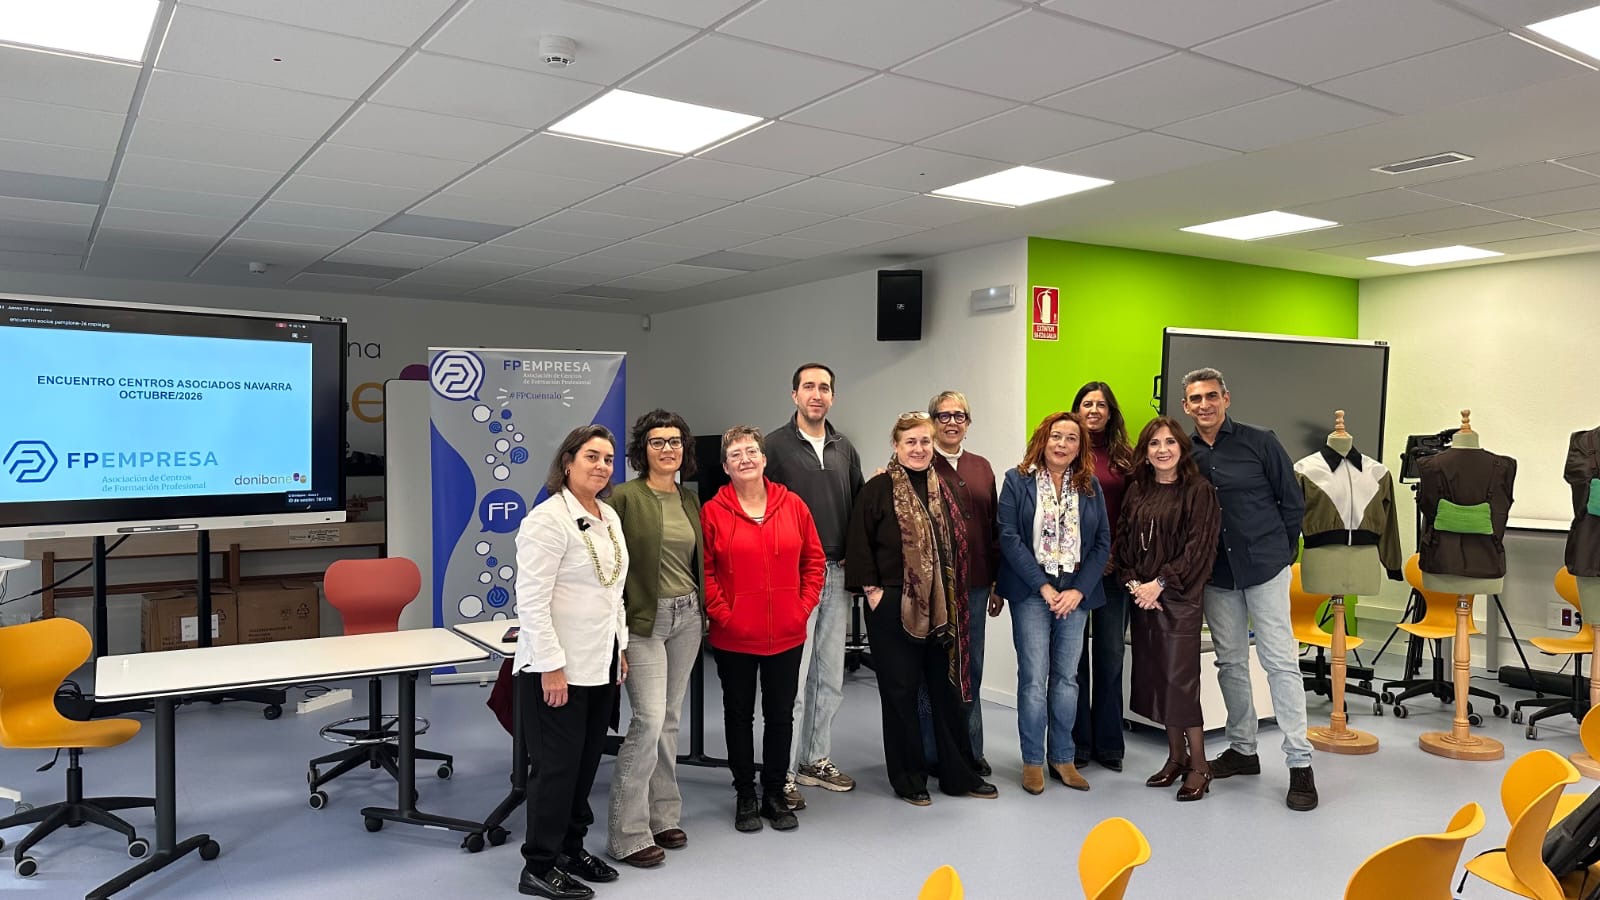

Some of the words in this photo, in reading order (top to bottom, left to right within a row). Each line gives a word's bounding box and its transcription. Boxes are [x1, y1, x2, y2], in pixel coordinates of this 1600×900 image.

[1036, 325, 1055, 333] EXTINTOR
[503, 360, 591, 372] FPEMPRESA
[37, 376, 115, 387] ENCUENTRO
[119, 378, 174, 388] CENTROS
[176, 379, 241, 390] ASOCIADOS
[244, 381, 292, 391] NAVARRA
[119, 390, 203, 401] OCTUBRE/2026
[67, 451, 219, 469] FPEMPRESA
[102, 475, 147, 483] Asociación
[149, 474, 159, 482] de
[160, 474, 192, 482] Centros
[234, 475, 293, 486] donibane
[102, 484, 113, 492] de
[115, 483, 159, 492] Formación
[161, 481, 206, 490] Profesional
[488, 502, 519, 521] FP
